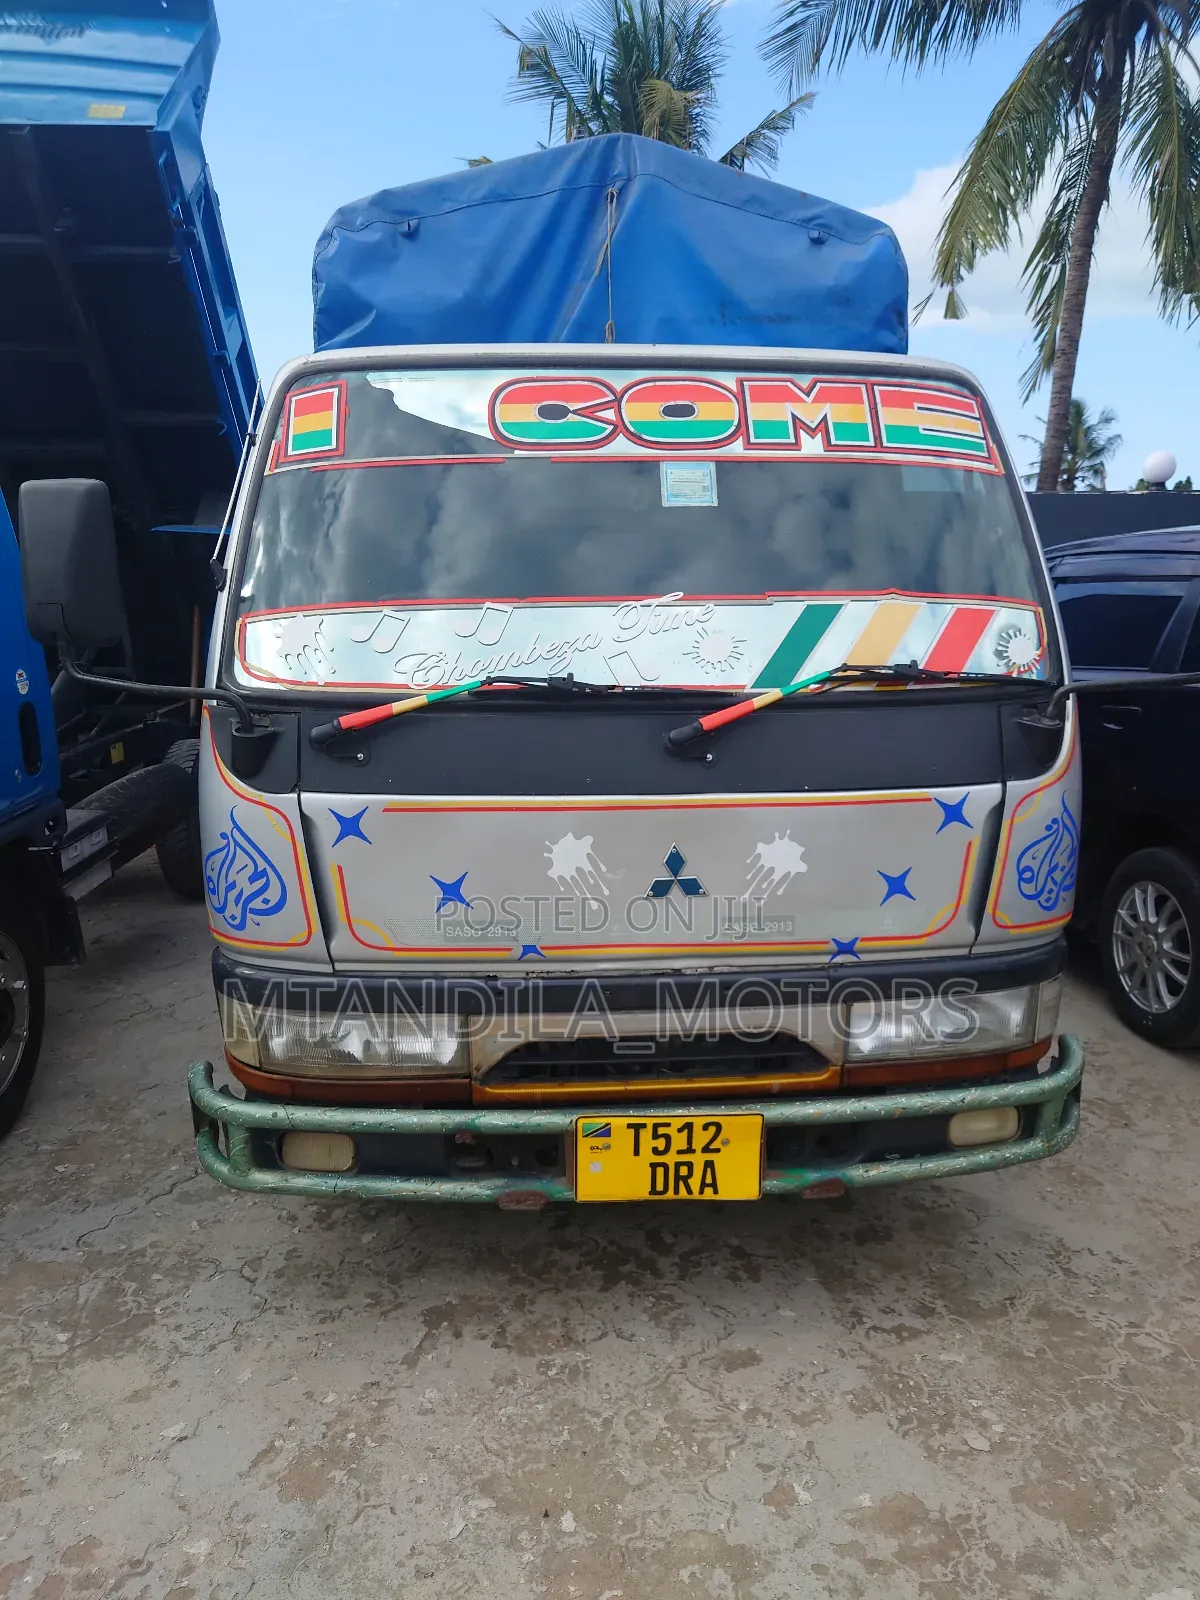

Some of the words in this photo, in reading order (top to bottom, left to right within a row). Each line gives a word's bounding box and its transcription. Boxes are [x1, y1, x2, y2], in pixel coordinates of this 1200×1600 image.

[488, 376, 994, 461] COME
[393, 632, 604, 690] Chombeza
[612, 591, 716, 643] Time
[446, 926, 481, 937] SASO
[765, 921, 793, 932] 2913
[626, 1121, 723, 1157] T512
[648, 1160, 719, 1196] DRA
